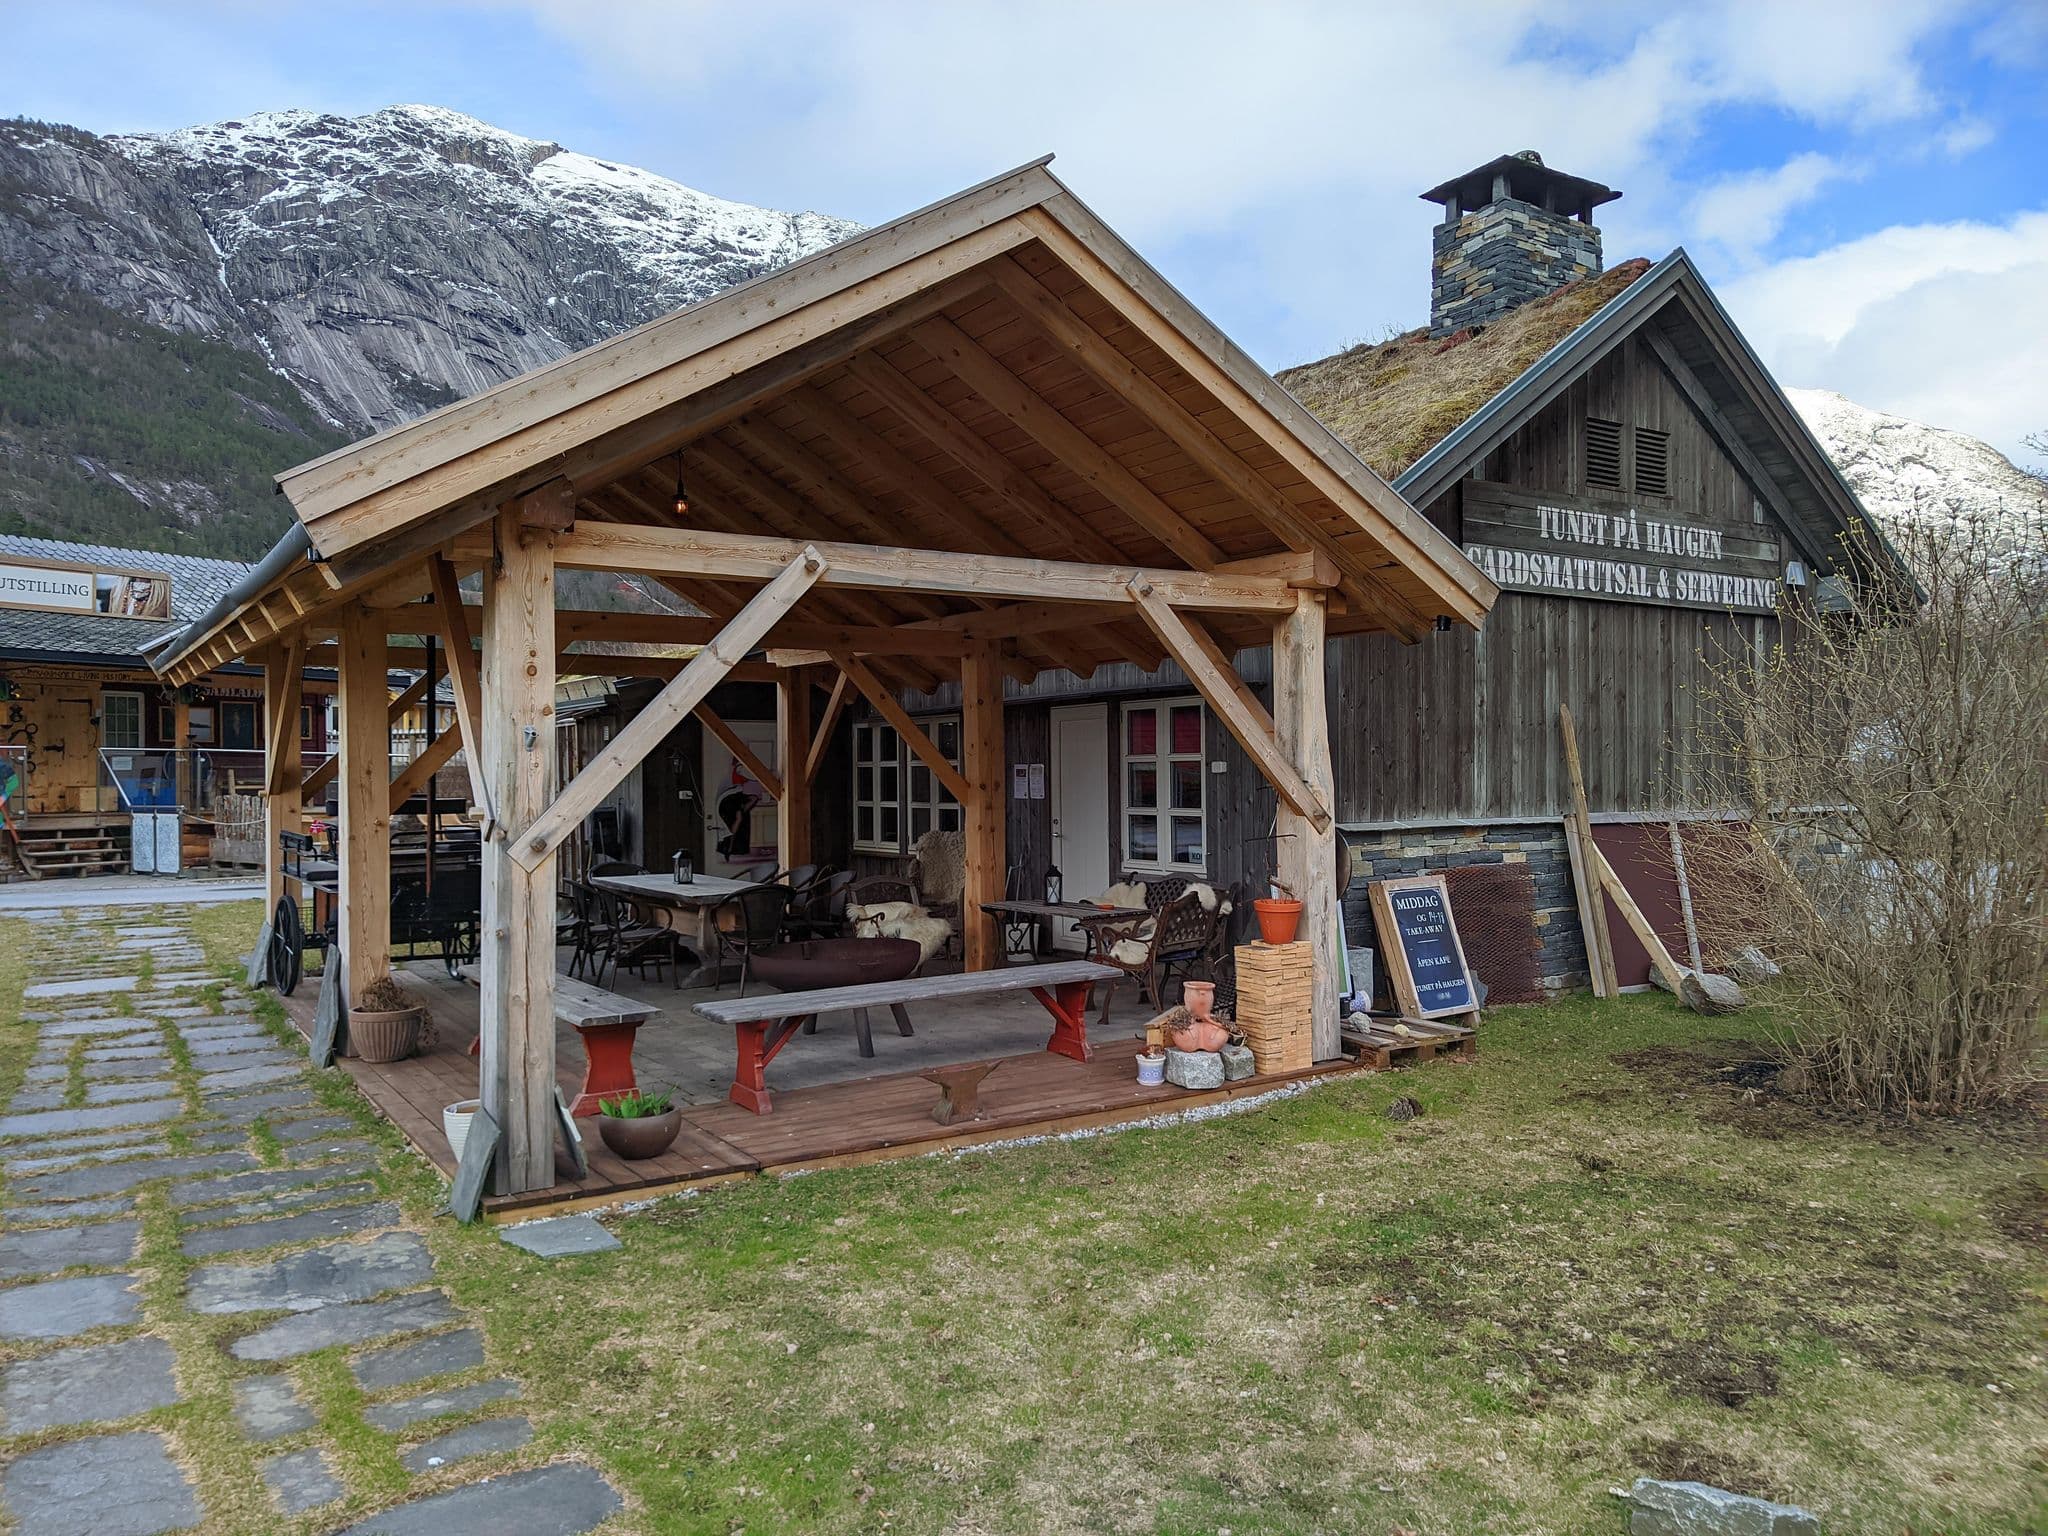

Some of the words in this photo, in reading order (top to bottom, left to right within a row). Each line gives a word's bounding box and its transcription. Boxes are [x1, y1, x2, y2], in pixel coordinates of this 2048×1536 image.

[1537, 505, 1608, 546] TUNET
[1613, 508, 1641, 550] PÅ
[1646, 521, 1723, 560] HAUGEN
[1656, 568, 1671, 599] &
[1676, 571, 1776, 609] SERVERING
[1396, 895, 1439, 910] MIDDAG
[1416, 914, 1427, 922] OG
